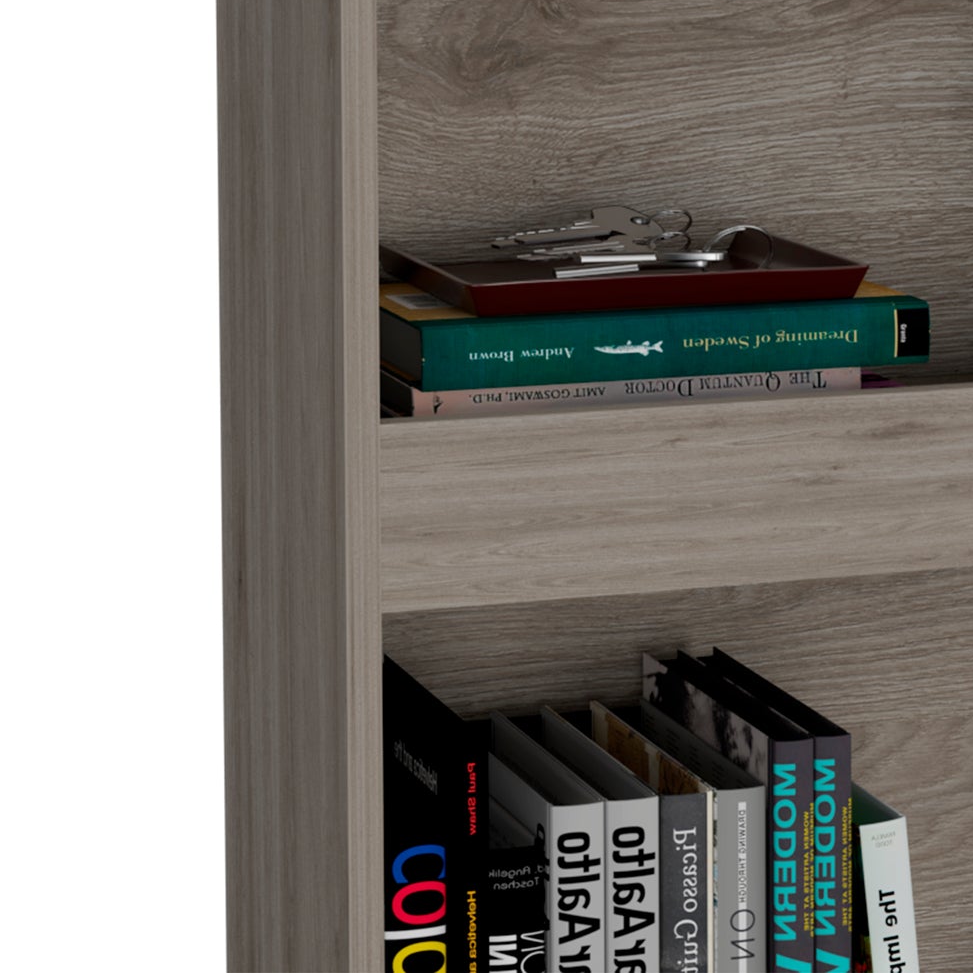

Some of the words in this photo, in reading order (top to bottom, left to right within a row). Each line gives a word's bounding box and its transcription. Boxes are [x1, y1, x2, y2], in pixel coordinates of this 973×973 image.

[682, 333, 750, 351] Sweden
[755, 329, 773, 347] of
[776, 327, 860, 345] Dreaming
[468, 348, 515, 363] Brown
[519, 345, 575, 361] Andrew
[624, 376, 694, 396] DOCTOR
[699, 372, 781, 393] QUANTUM
[788, 370, 828, 389] THE
[506, 388, 570, 403] GOSWAMI,
[572, 385, 606, 399] AMIT
